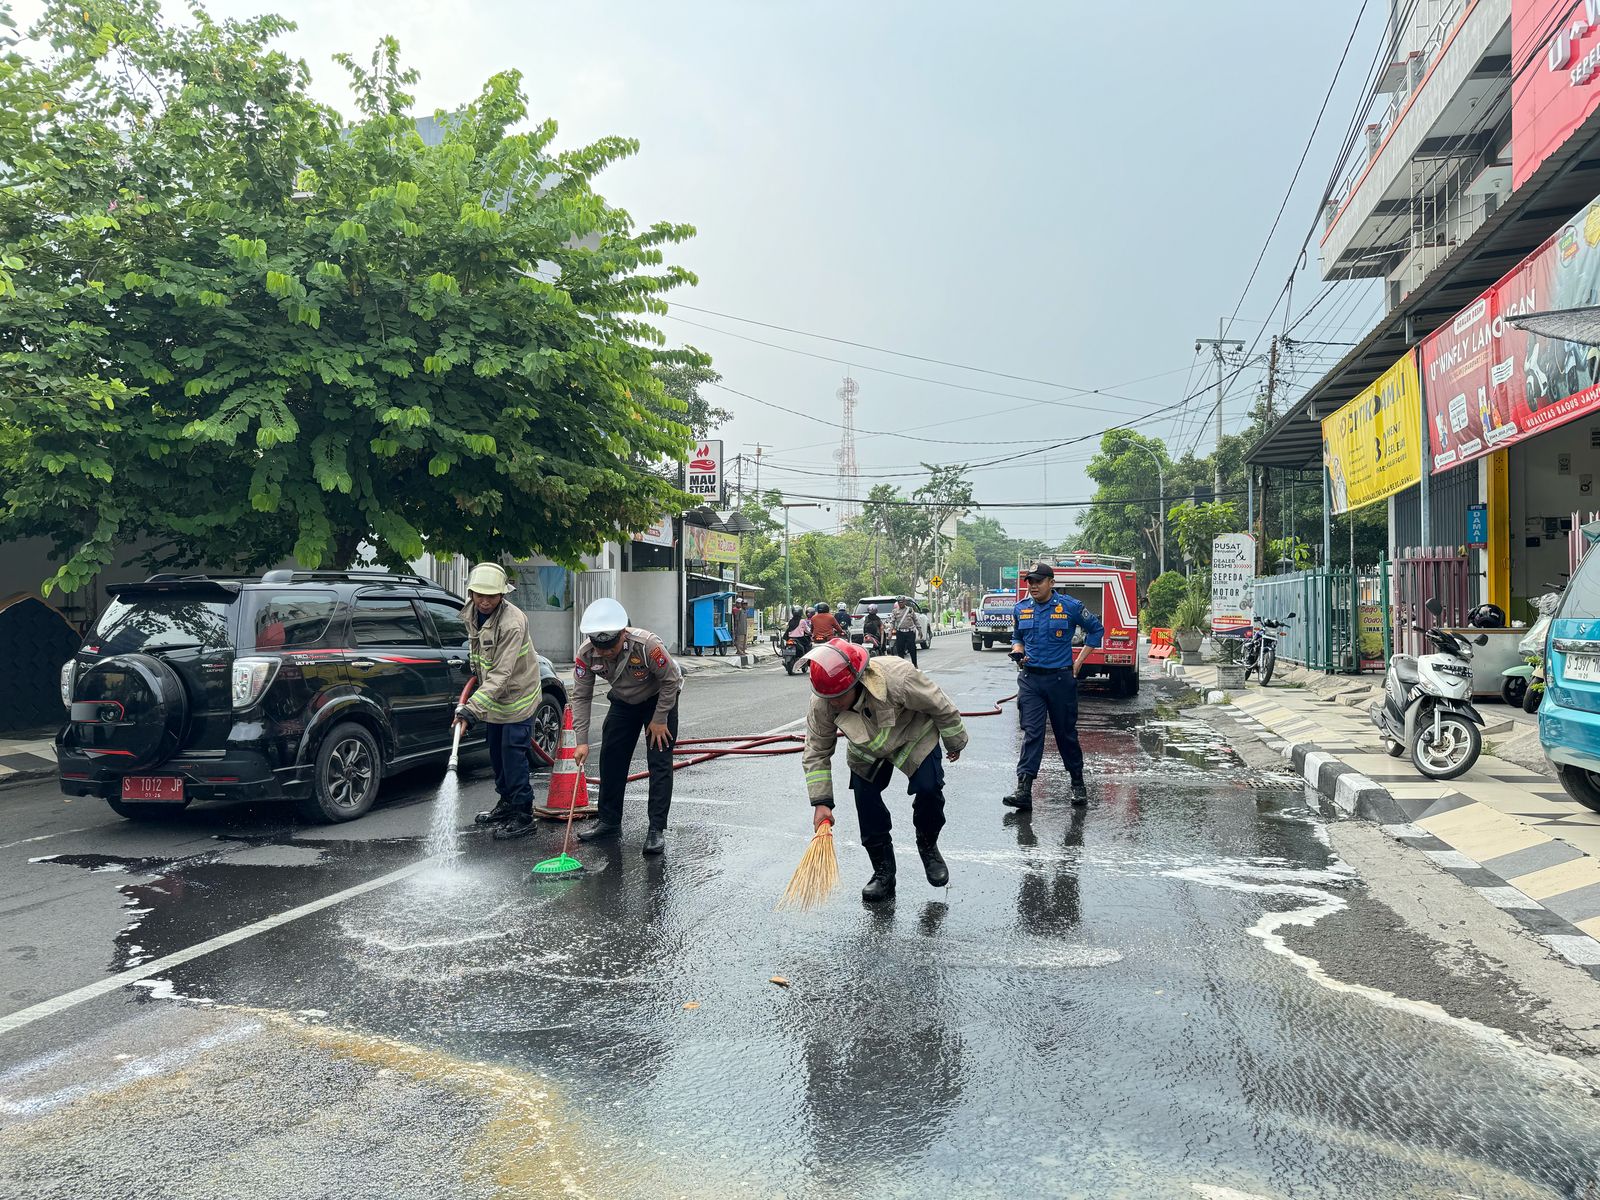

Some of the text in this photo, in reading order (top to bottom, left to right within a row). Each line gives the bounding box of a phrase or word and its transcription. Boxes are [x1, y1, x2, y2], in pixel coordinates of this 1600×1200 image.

[1526, 409, 1556, 428] KUALITAS
[1556, 398, 1579, 415] BAGUS
[690, 475, 716, 485] MAU
[1473, 511, 1481, 542] DAMAI
[1213, 573, 1243, 581] SEPEDA
[1213, 588, 1239, 596] MOTOR
[124, 779, 183, 792] S 1012 JP
